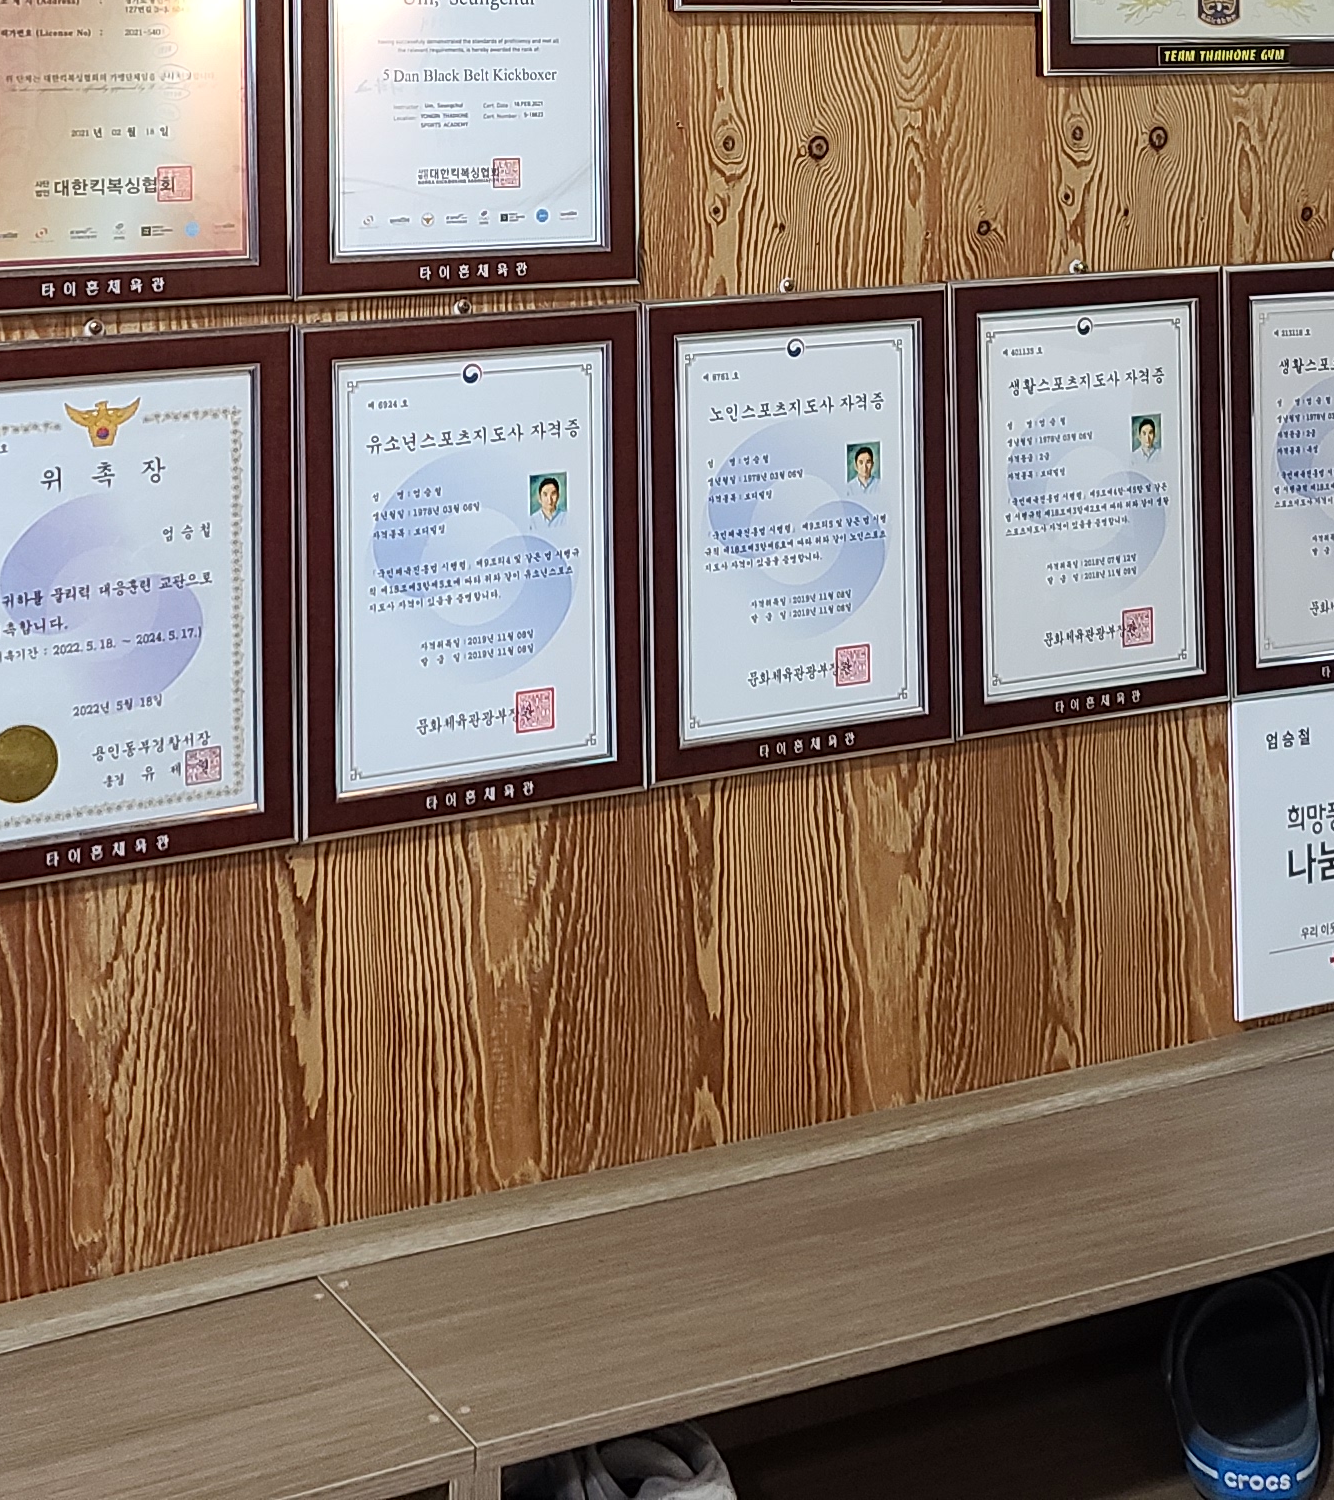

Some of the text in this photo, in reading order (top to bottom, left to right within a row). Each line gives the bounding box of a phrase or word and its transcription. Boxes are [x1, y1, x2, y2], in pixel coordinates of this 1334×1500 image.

[1164, 48, 1284, 62] TEAM THAIHONE GYM
[383, 68, 557, 82] 5 Dan Black Belt Kickboxer
[419, 261, 528, 280] 타이혼체육관
[41, 276, 166, 298] 타이혼체육관
[1008, 367, 1165, 396] 생활스포츠지도사 자격증
[709, 392, 885, 423] 노인스포츠지도사 자격증
[366, 419, 581, 455] 유소년스포츠지도사 자격증
[41, 457, 166, 493] 위촉장
[1055, 690, 1141, 714] 타이혼체육관
[759, 731, 856, 759] 타이혼체육관
[1266, 729, 1311, 750] 엄승철
[426, 781, 534, 811] 타이혼체육관
[46, 834, 170, 868] 타이혼체육관
[1301, 925, 1318, 939] 우리
[1224, 1470, 1292, 1492] crocs
